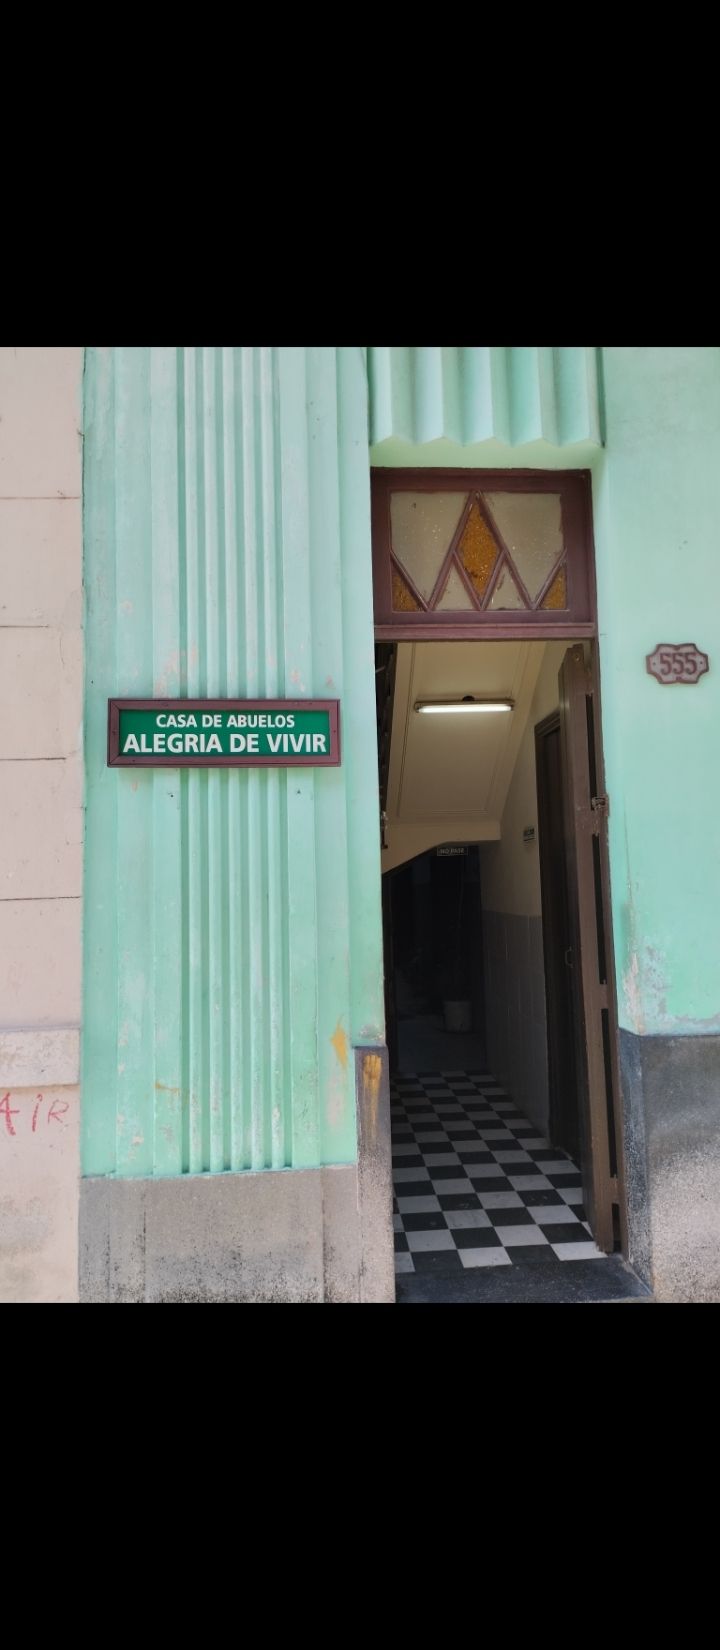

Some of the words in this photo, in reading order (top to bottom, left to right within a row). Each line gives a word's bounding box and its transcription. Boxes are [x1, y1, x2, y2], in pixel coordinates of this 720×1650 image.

[660, 652, 697, 675] 555
[156, 714, 198, 728] CASA
[201, 714, 222, 728] DE
[226, 714, 295, 728] ABUELOS
[122, 733, 223, 753] ALEGRIA
[229, 733, 259, 753] DE
[266, 733, 327, 753] VIVIR
